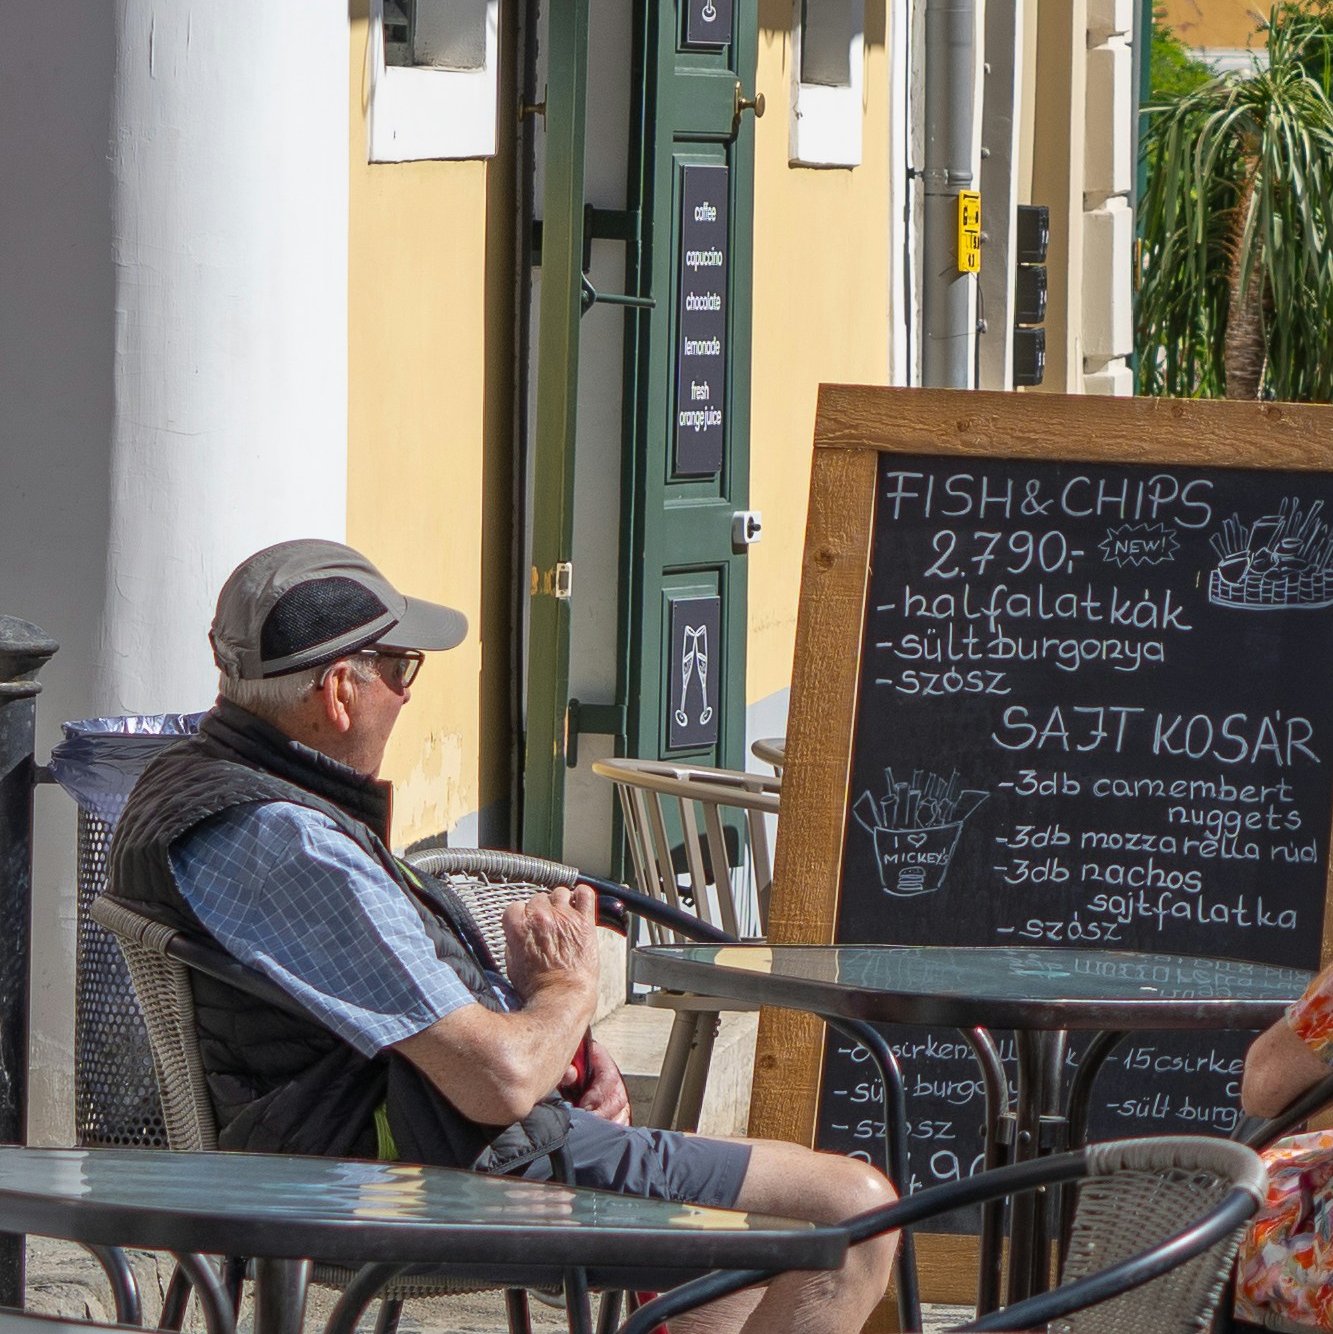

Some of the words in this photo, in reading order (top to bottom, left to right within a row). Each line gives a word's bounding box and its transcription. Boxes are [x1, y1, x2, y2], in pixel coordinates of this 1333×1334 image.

[694, 202, 716, 222] coffee
[686, 247, 723, 272] capuccino
[686, 291, 721, 312] chocolate
[684, 336, 721, 356] lemonade
[691, 380, 709, 401] fresh
[679, 411, 704, 432] orange
[704, 408, 722, 432] juice
[1114, 535, 1168, 557] NEW!
[1153, 709, 1322, 766] KOSÁR
[1093, 774, 1295, 803] camembert
[1168, 803, 1302, 840] nuggets
[1080, 857, 1203, 894] nachos
